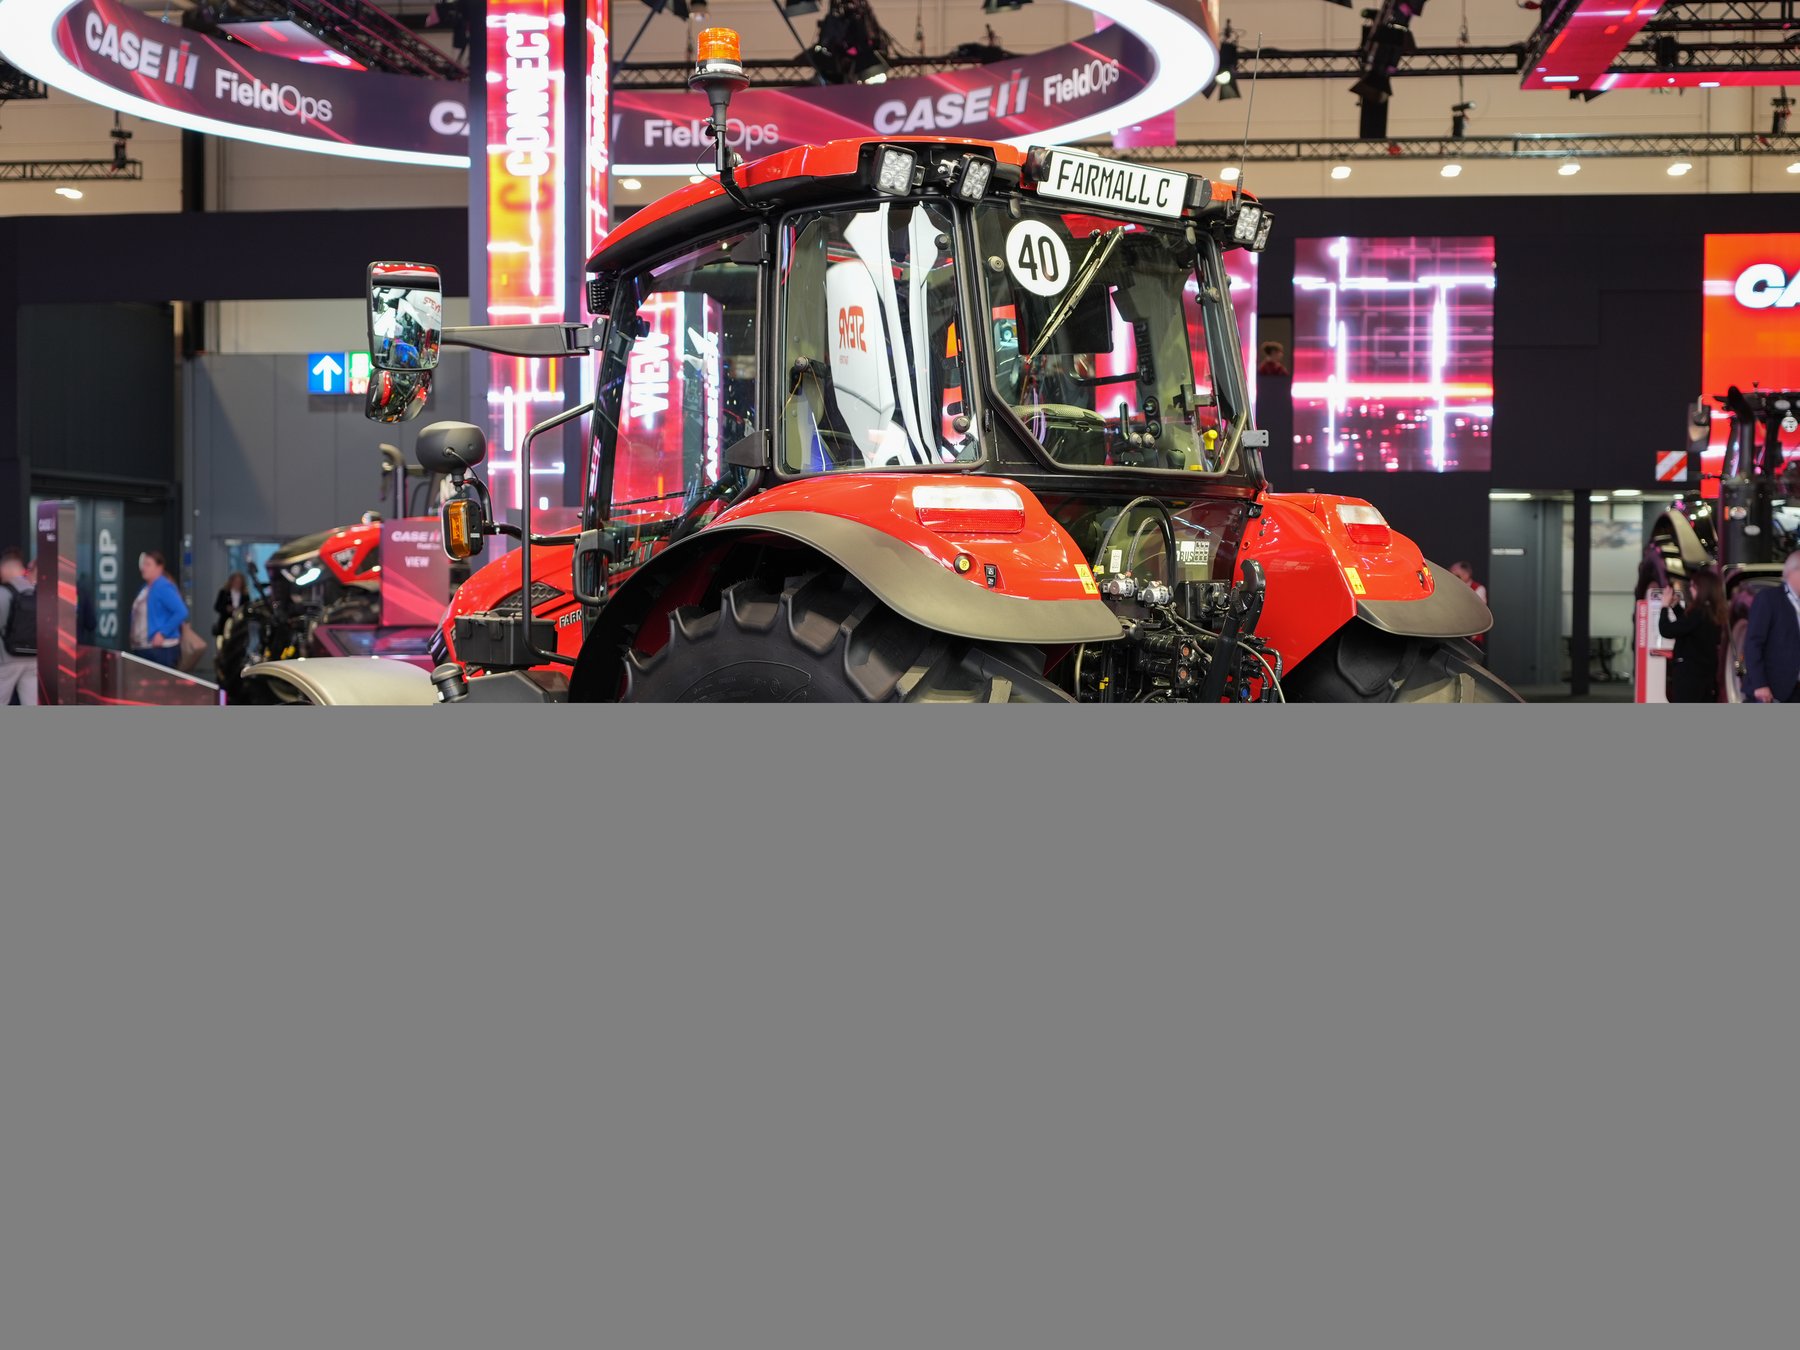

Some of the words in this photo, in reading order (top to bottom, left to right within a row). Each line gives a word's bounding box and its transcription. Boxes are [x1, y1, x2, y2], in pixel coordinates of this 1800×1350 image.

[85, 10, 163, 79] CASE
[215, 67, 333, 124] FieldOps
[506, 12, 550, 176] CONNECT
[1043, 59, 1120, 107] FieldOps
[429, 99, 470, 136] C
[873, 86, 994, 135] CASE
[1056, 159, 1151, 205] FARMALL
[1156, 178, 1171, 208] C
[1018, 233, 1059, 282] 40
[391, 530, 429, 543] CASE
[99, 528, 118, 638] SHOP
[405, 556, 430, 568] VIEW
